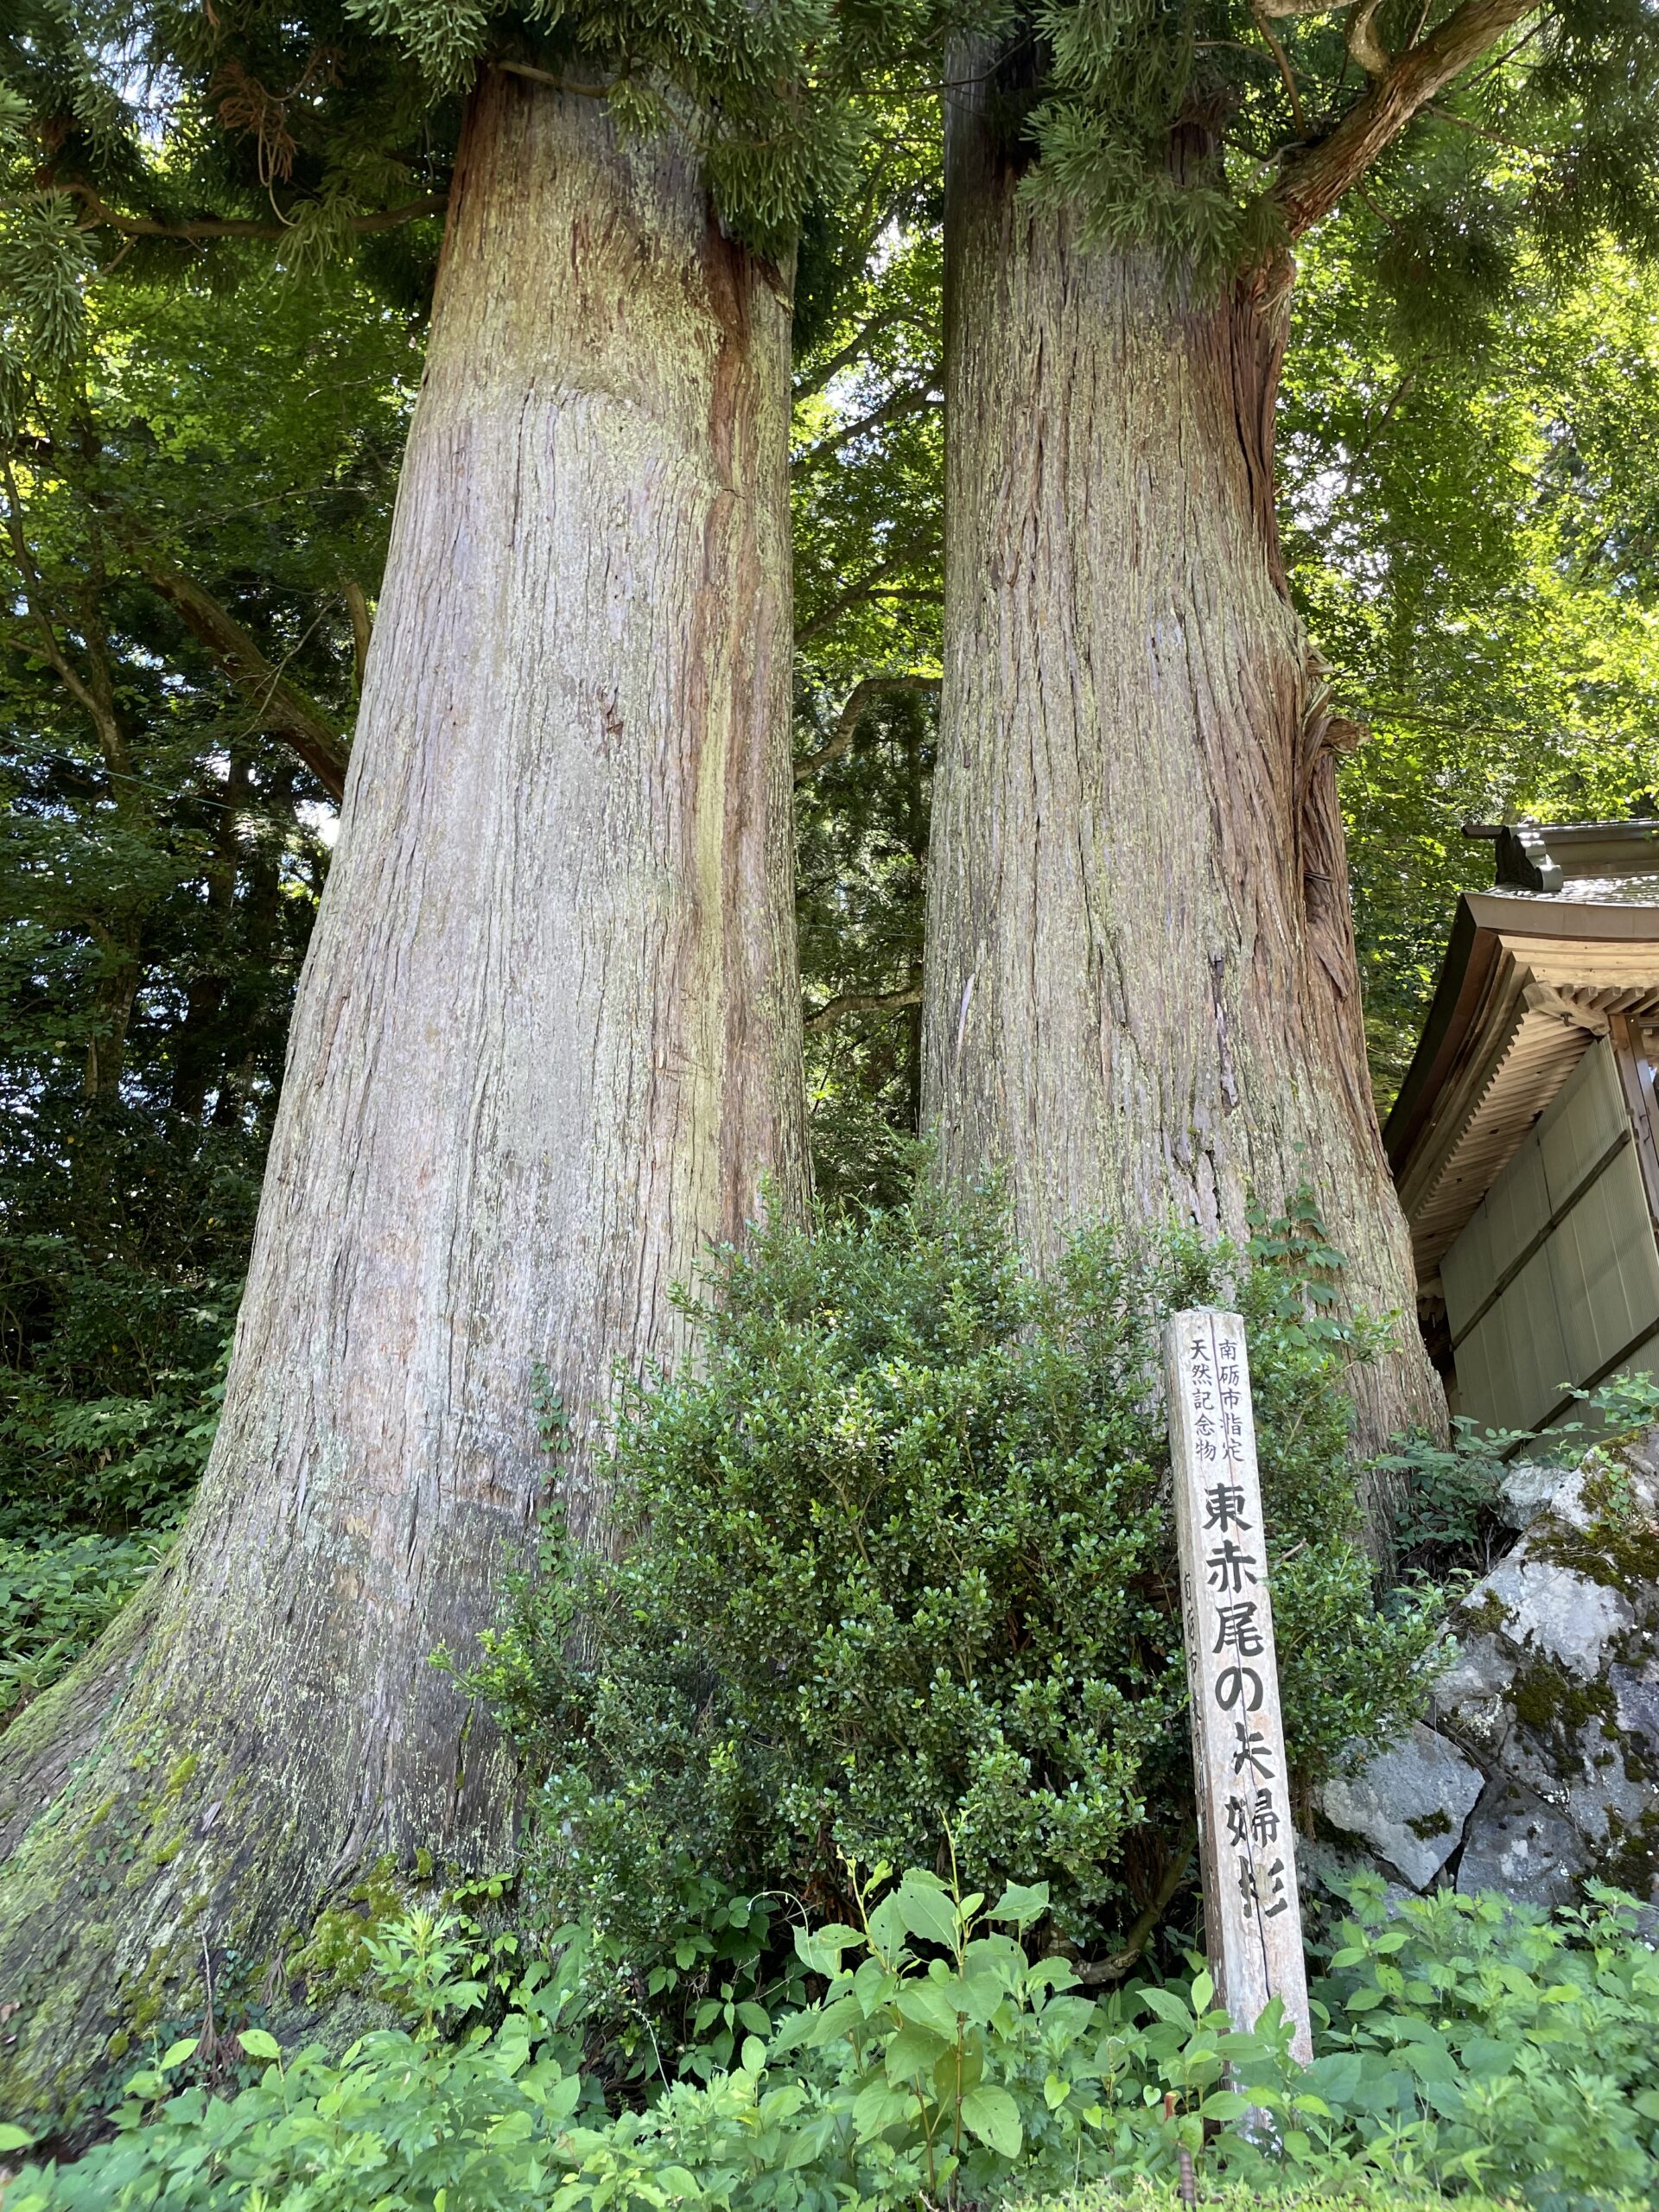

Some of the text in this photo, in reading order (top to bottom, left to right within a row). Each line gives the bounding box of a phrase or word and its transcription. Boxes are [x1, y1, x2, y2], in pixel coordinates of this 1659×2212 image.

[1190, 1338, 1217, 1462] 天然記念物
[1217, 1338, 1245, 1462] 南砺市指定
[1202, 1482, 1288, 1918] 東赤尾の夫婦杉
